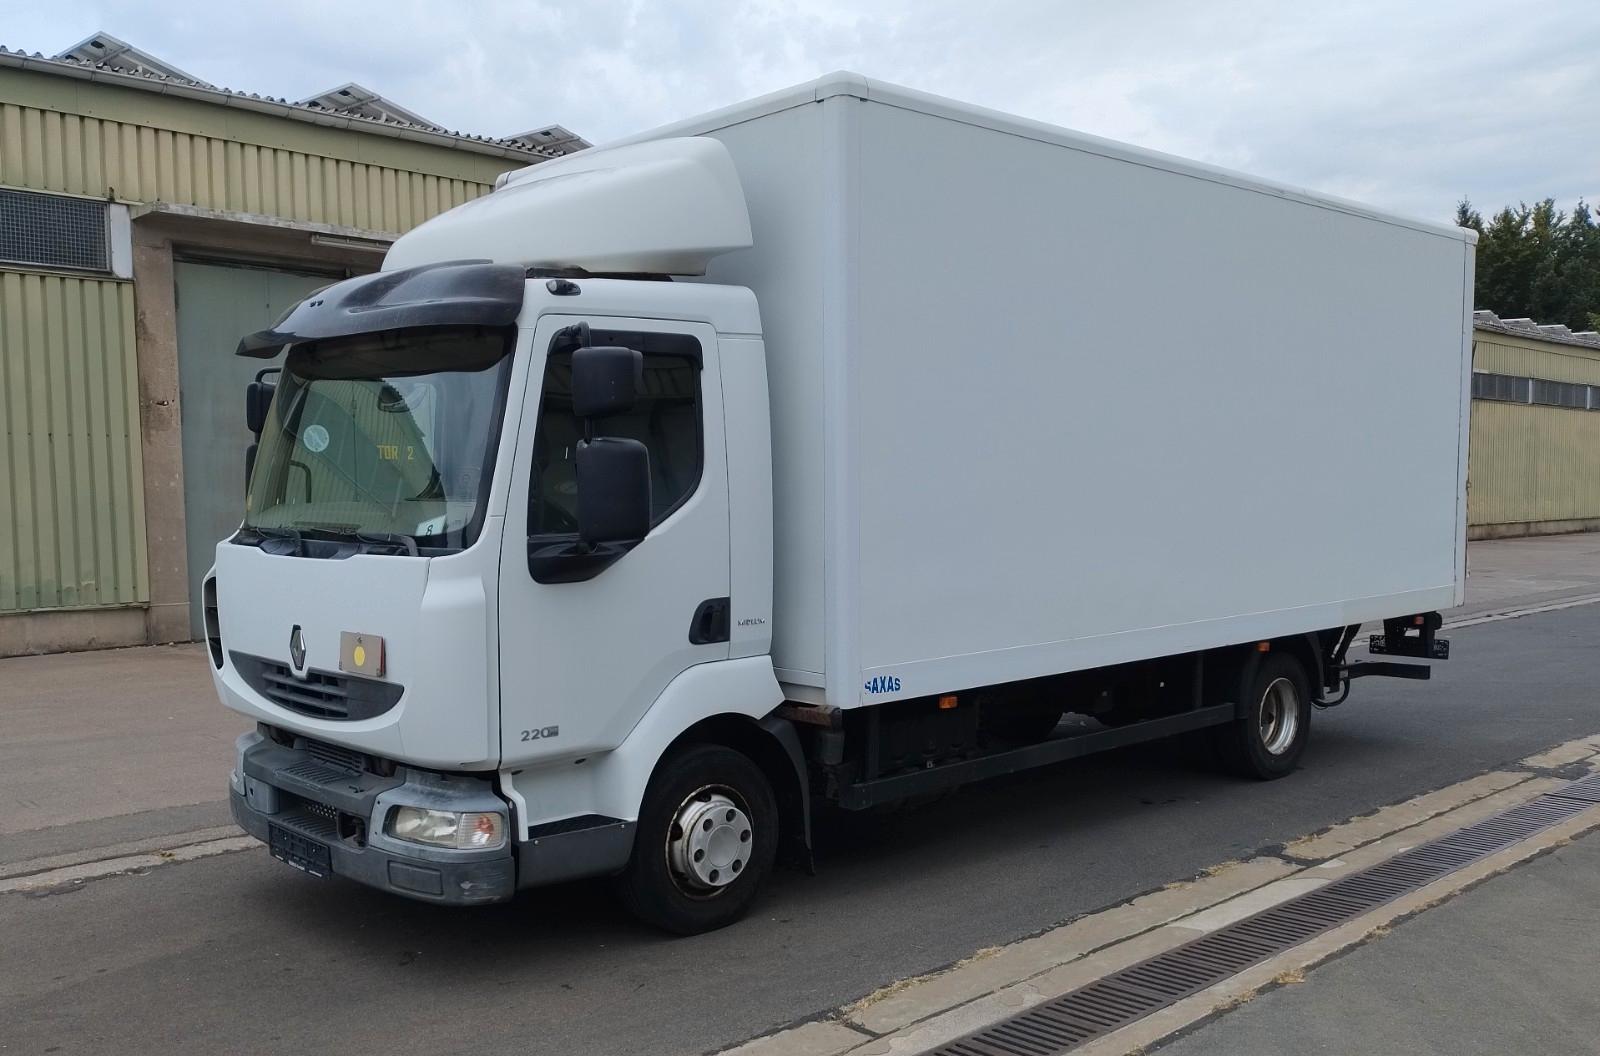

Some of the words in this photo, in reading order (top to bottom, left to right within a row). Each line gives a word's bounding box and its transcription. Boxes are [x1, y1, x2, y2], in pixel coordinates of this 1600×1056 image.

[376, 445, 398, 460] TOR
[407, 445, 415, 460] 2
[521, 727, 550, 742] 220
